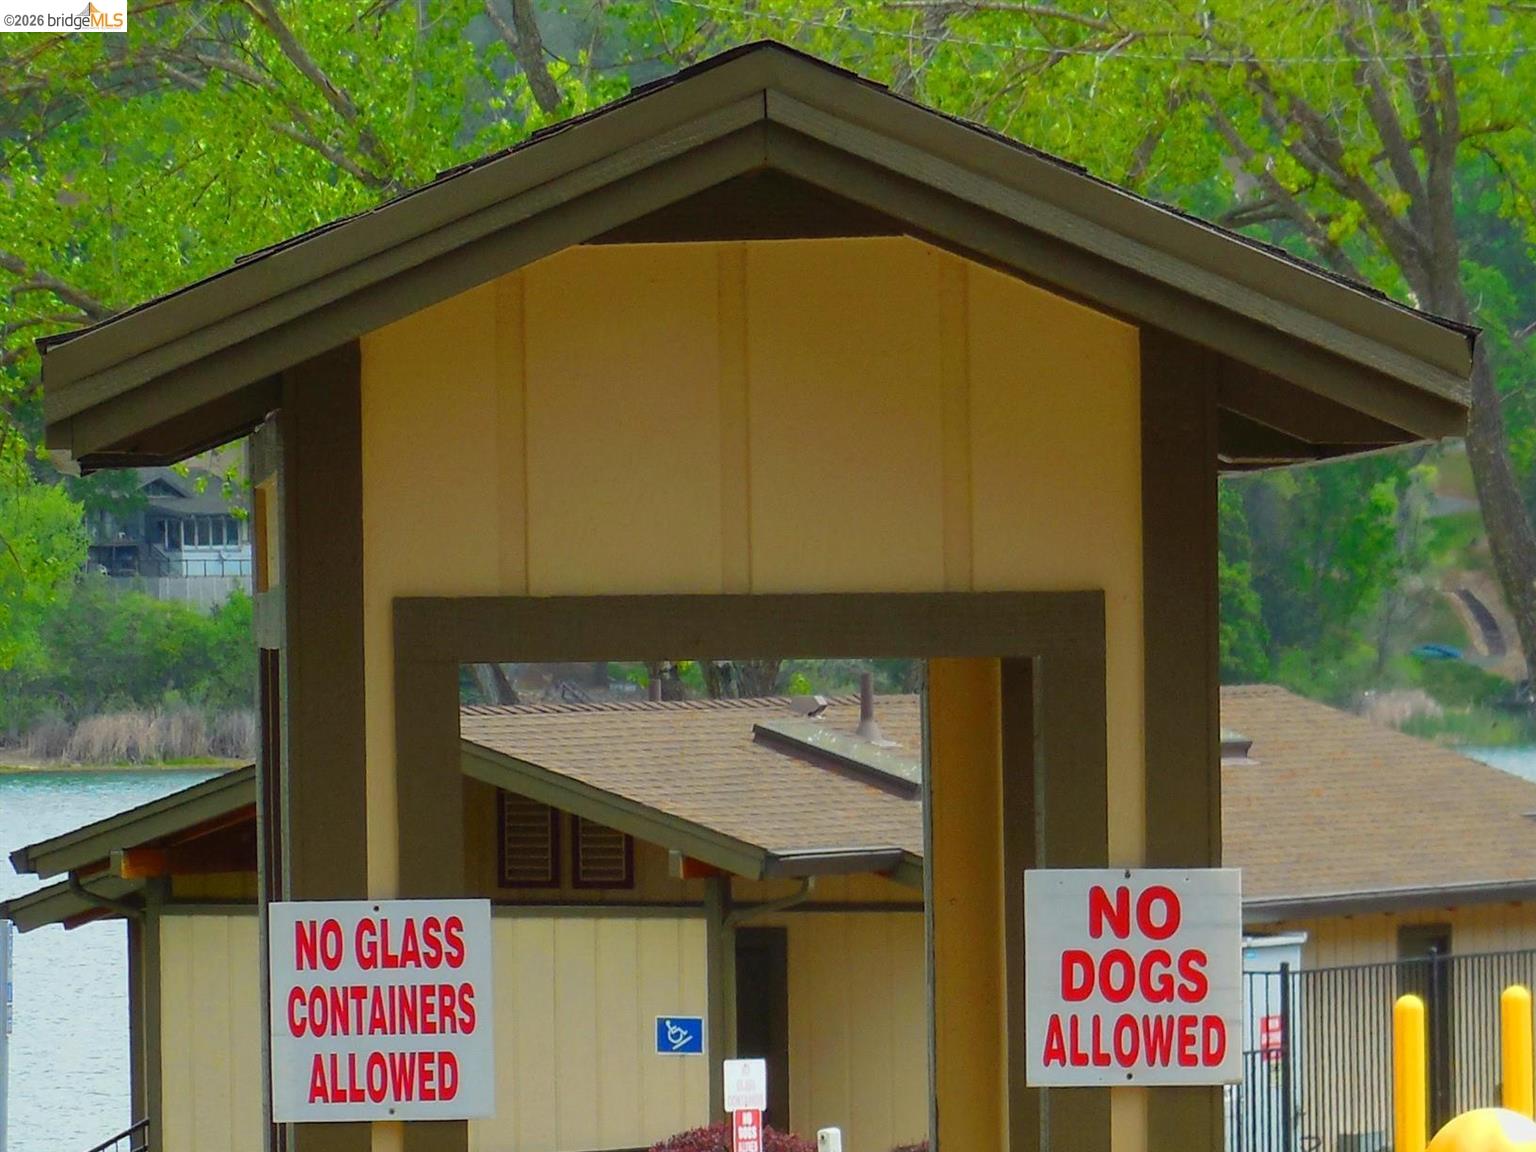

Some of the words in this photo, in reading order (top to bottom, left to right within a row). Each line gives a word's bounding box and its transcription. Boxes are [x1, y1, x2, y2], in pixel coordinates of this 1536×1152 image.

[1088, 885, 1181, 940] NO
[294, 917, 344, 972] NO
[354, 916, 466, 971] GLASS
[1061, 948, 1209, 1003] DOGS
[287, 982, 477, 1038] CONTAINERS
[1042, 1013, 1227, 1068] ALLOWED
[308, 1051, 460, 1104] ALLOWED
